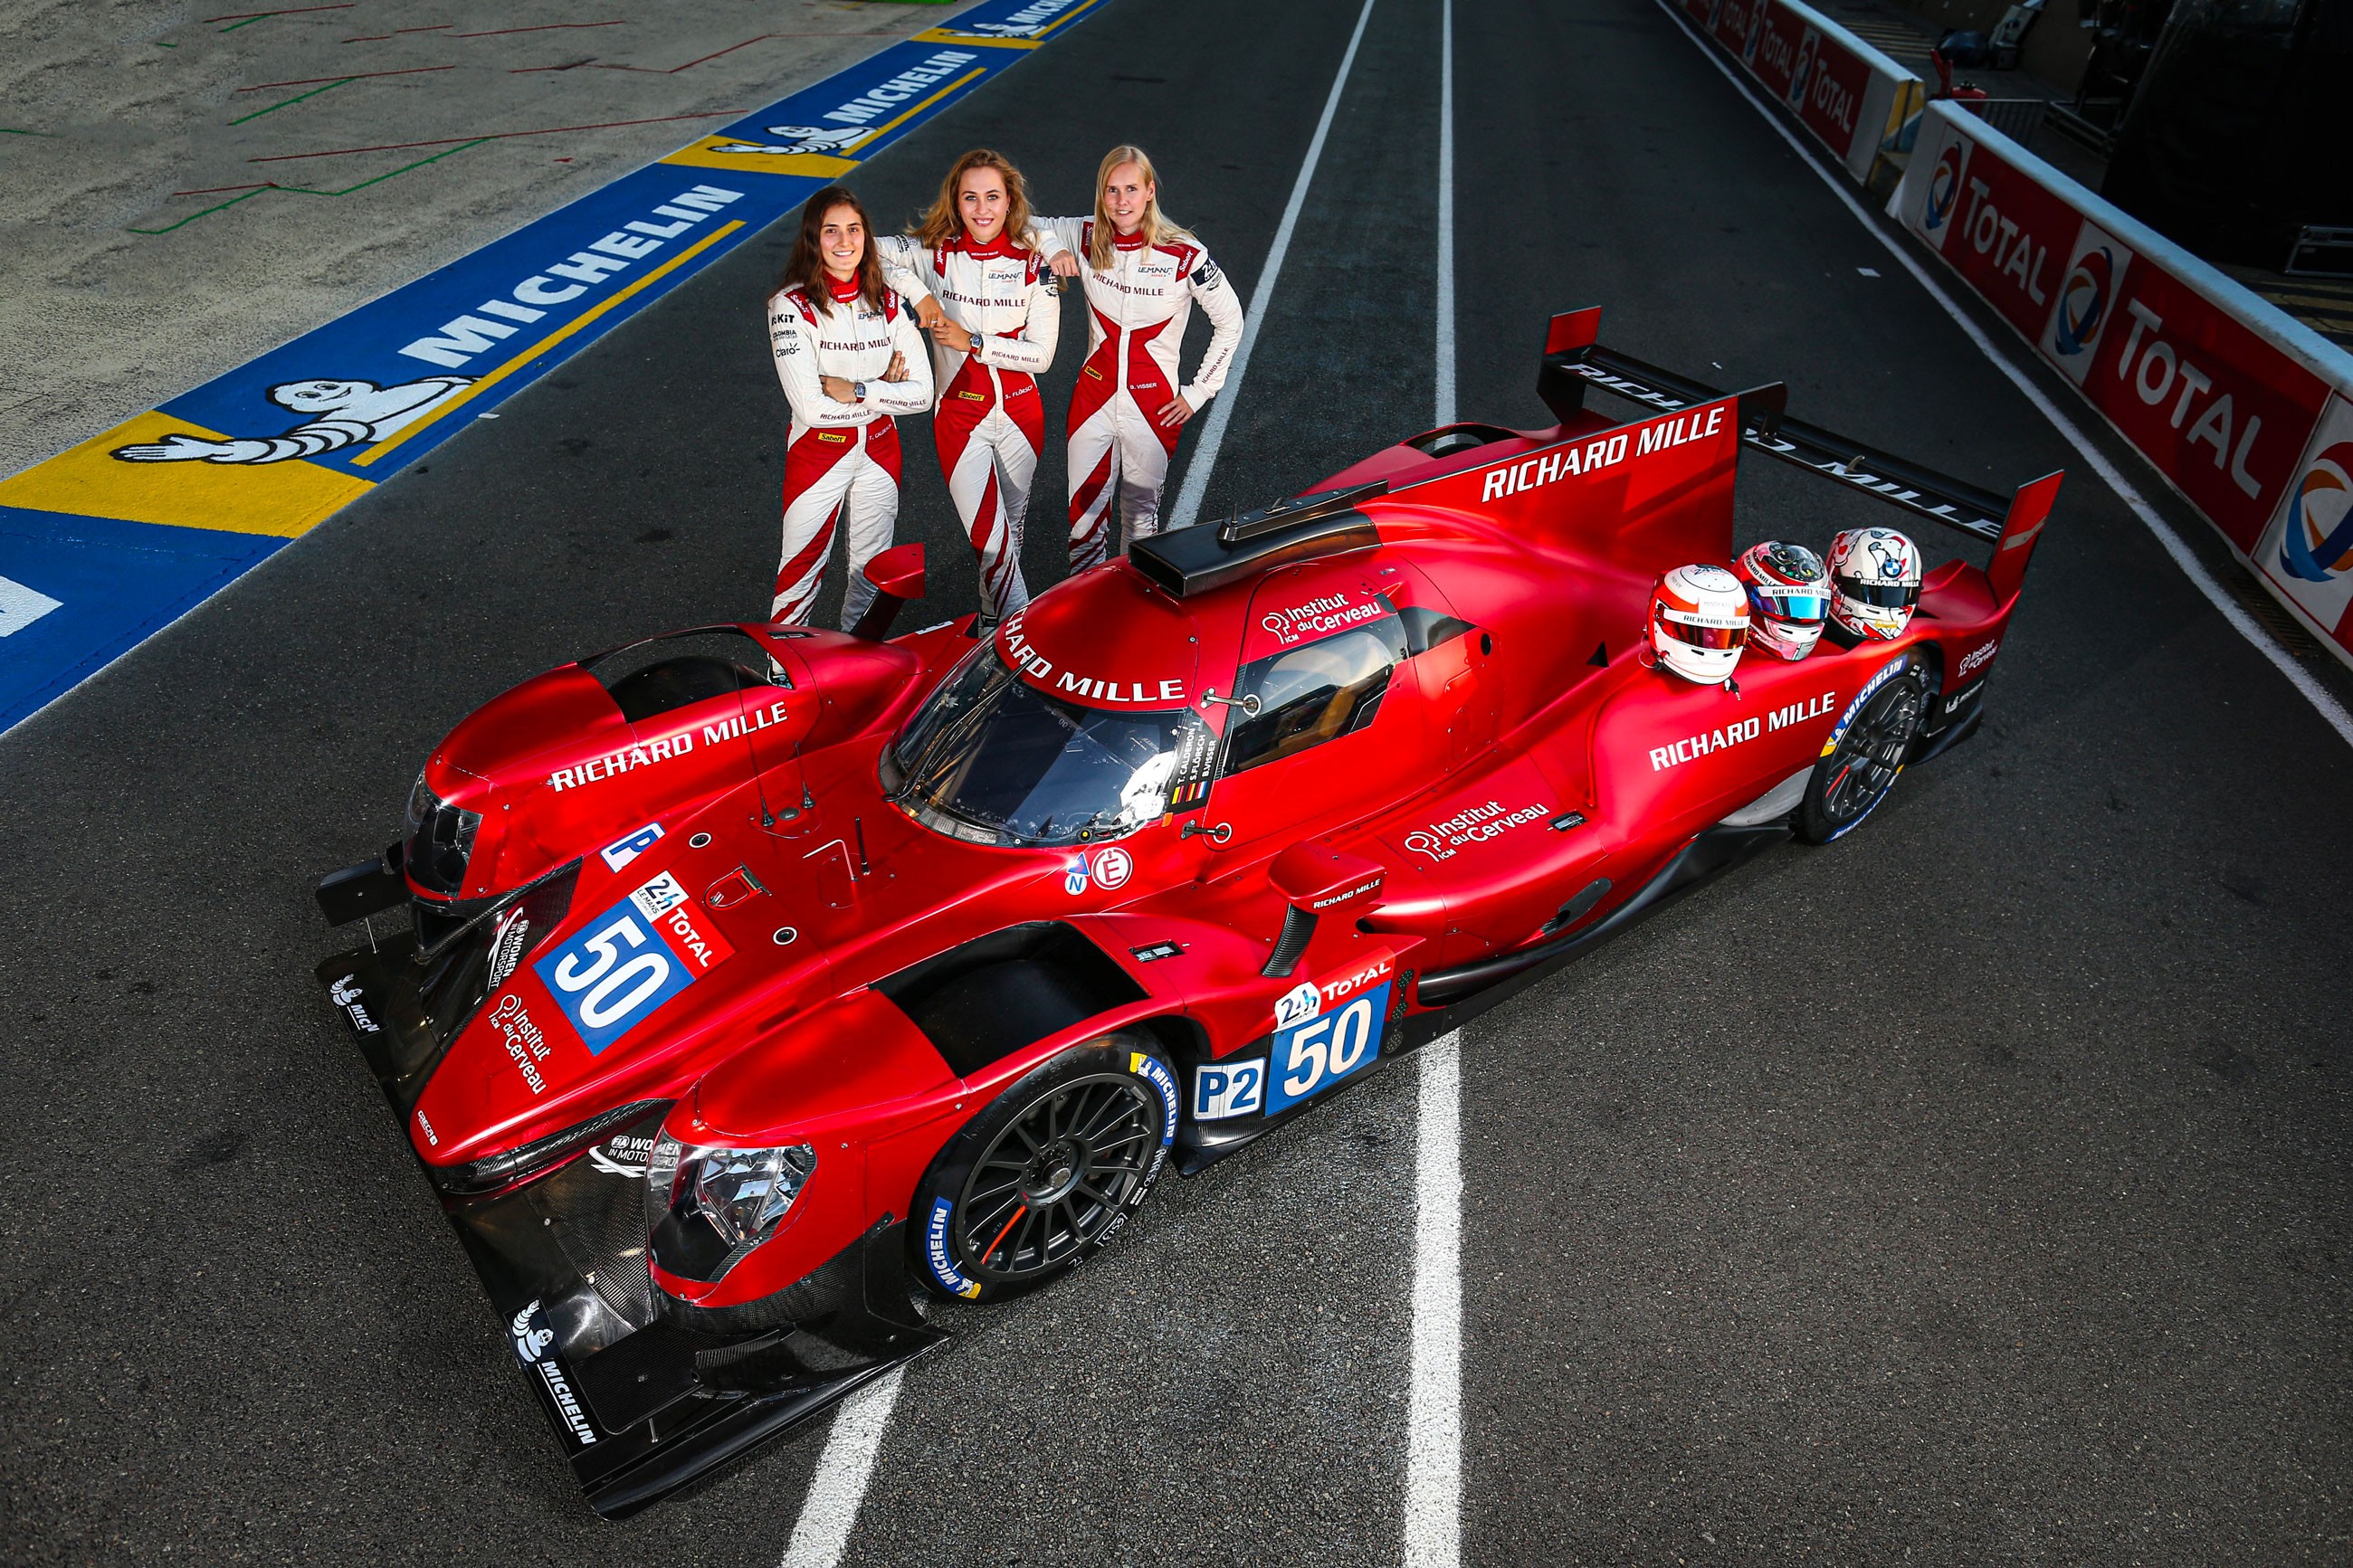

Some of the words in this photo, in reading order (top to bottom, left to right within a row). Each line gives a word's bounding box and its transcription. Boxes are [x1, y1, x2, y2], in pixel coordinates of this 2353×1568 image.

[1005, 0, 1074, 24] MICH
[1764, 18, 1792, 79] TOTAL
[823, 51, 977, 125] MICHELIN
[1812, 58, 1853, 133] TOTAL
[1962, 176, 2047, 307] TOTAL
[397, 185, 746, 369] MICHELIN
[1179, 249, 1194, 272] Sabelt
[942, 290, 991, 307] RICHARD
[994, 299, 1026, 307] MILLE
[1093, 273, 1131, 294] RICHARD
[1133, 287, 1165, 296] MILLE
[776, 346, 796, 358] Claro
[820, 340, 866, 352] RICHARD
[991, 350, 1020, 361] RICHARD
[1021, 356, 1041, 364] MILLE
[1202, 364, 1218, 385] ICHARD
[1216, 347, 1230, 366] MILLE
[879, 397, 909, 407] RICHARD
[908, 398, 928, 407] MILLE
[961, 391, 983, 401] Sabelt
[1137, 382, 1157, 390] VISSER
[2119, 297, 2262, 501] TOTAL
[819, 413, 852, 421] RICHARD
[851, 409, 872, 419] MILLE
[821, 433, 844, 442] Sabelt
[1481, 432, 1628, 503] RICHARD
[1634, 406, 1725, 457] MILLE
[1813, 461, 2004, 539] MILLE
[1860, 578, 1900, 587] RICHARD
[1285, 593, 1349, 622] Institut
[1297, 622, 1313, 632] du
[1312, 602, 1382, 632] Cerveau
[1683, 614, 1722, 625] RICHARD
[1284, 633, 1300, 643] ICM
[1055, 671, 1186, 702] MILLE
[1843, 658, 1903, 725] MICHELIN
[550, 734, 693, 794] RICHARD
[703, 701, 788, 748] MILLE
[1648, 716, 1760, 772] RICHARD
[1767, 691, 1837, 734] MILLE
[1179, 727, 1196, 775] CALDERON
[1176, 775, 1186, 784] T.
[1429, 800, 1506, 838] Institut
[1449, 833, 1470, 846] du
[1466, 803, 1549, 842] Cerveau
[1102, 858, 1122, 883] E
[1437, 849, 1457, 860] ICM
[1069, 876, 1083, 892] N
[1313, 889, 1356, 909] RICHARD
[1356, 879, 1382, 898] MILLE
[636, 889, 647, 900] LE
[643, 897, 661, 915] MANS
[668, 907, 713, 968] TOTAL
[491, 931, 515, 988] MOTORSPORT
[502, 933, 525, 977] WOMEN
[554, 916, 670, 1030] 50
[1321, 963, 1391, 1001] TOTAL
[490, 1016, 501, 1030] ICM
[502, 1022, 516, 1038] du
[512, 1008, 552, 1062] Institut
[505, 1034, 548, 1095] Cerveau
[1283, 997, 1373, 1098] 50
[1150, 1064, 1177, 1139] MICHELIN
[1196, 1066, 1260, 1114] P2
[607, 1147, 617, 1156] IN
[929, 1207, 961, 1287] MICHELIN
[540, 1360, 598, 1445] MICHELIN
